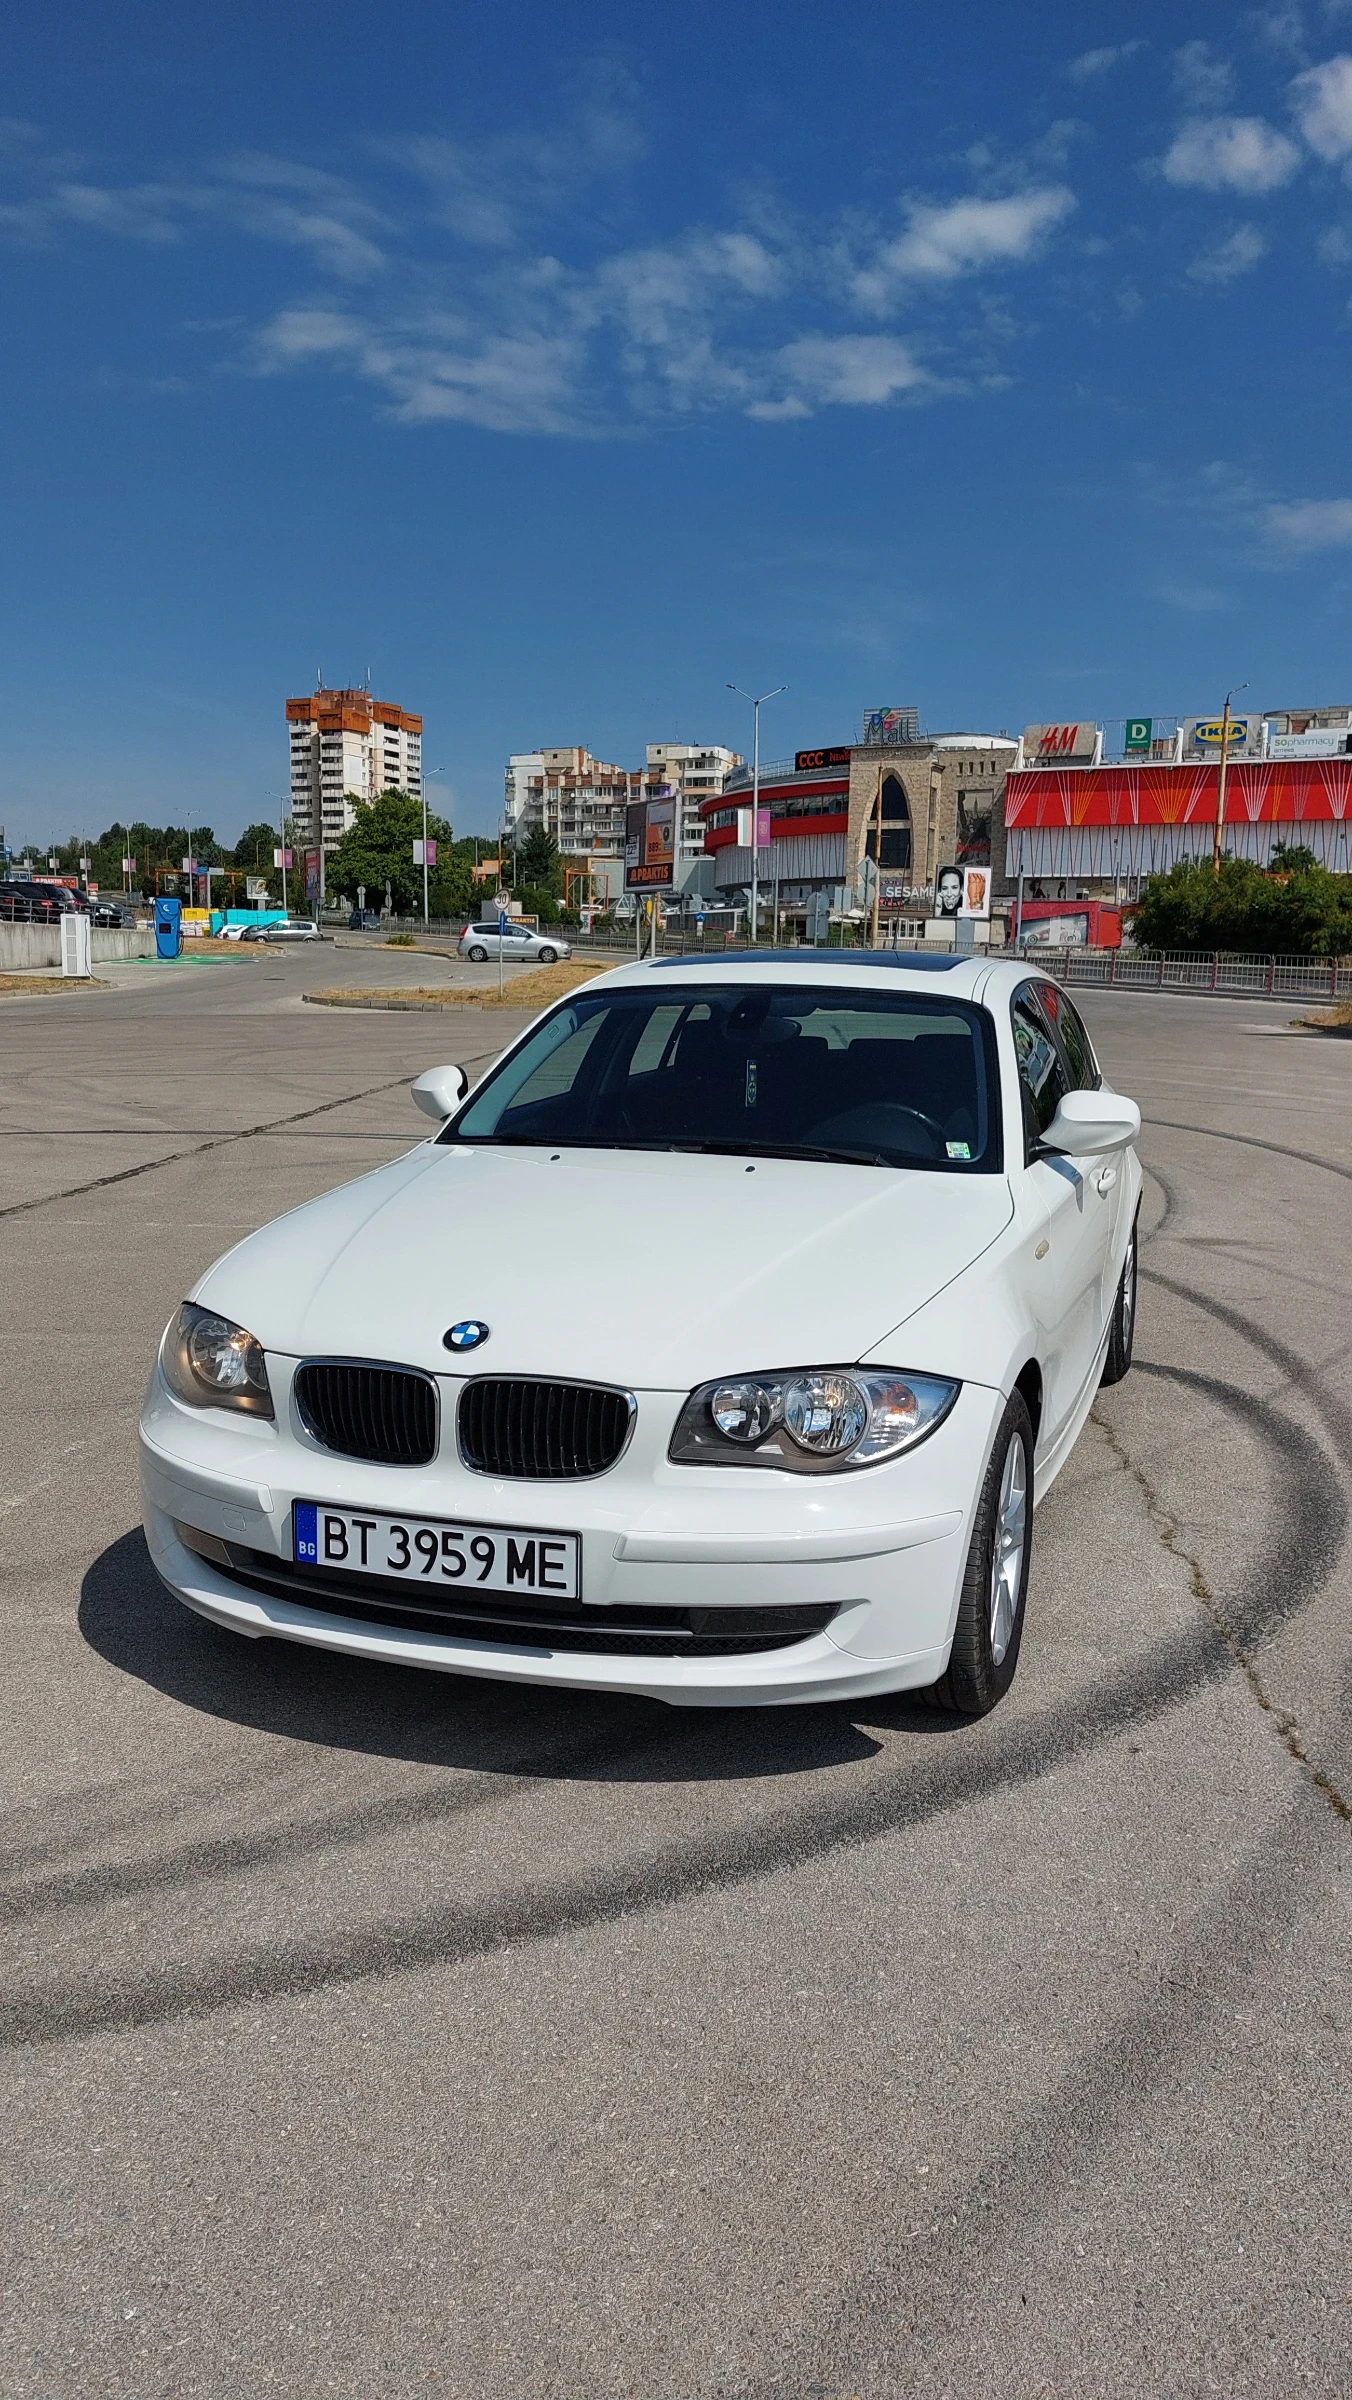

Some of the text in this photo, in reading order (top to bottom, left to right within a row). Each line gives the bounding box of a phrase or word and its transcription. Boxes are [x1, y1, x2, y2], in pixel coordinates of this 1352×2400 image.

[867, 719, 914, 744] Mall
[1131, 724, 1147, 739] D
[1040, 726, 1078, 754] H&M
[1274, 737, 1334, 748] sopharmacy
[799, 751, 824, 768] CCC
[637, 865, 669, 882] PRAKTIS
[496, 893, 507, 905] 30
[885, 886, 935, 898] SESAME
[299, 1541, 316, 1557] BG
[324, 1514, 567, 1590] BT 3959 ME
